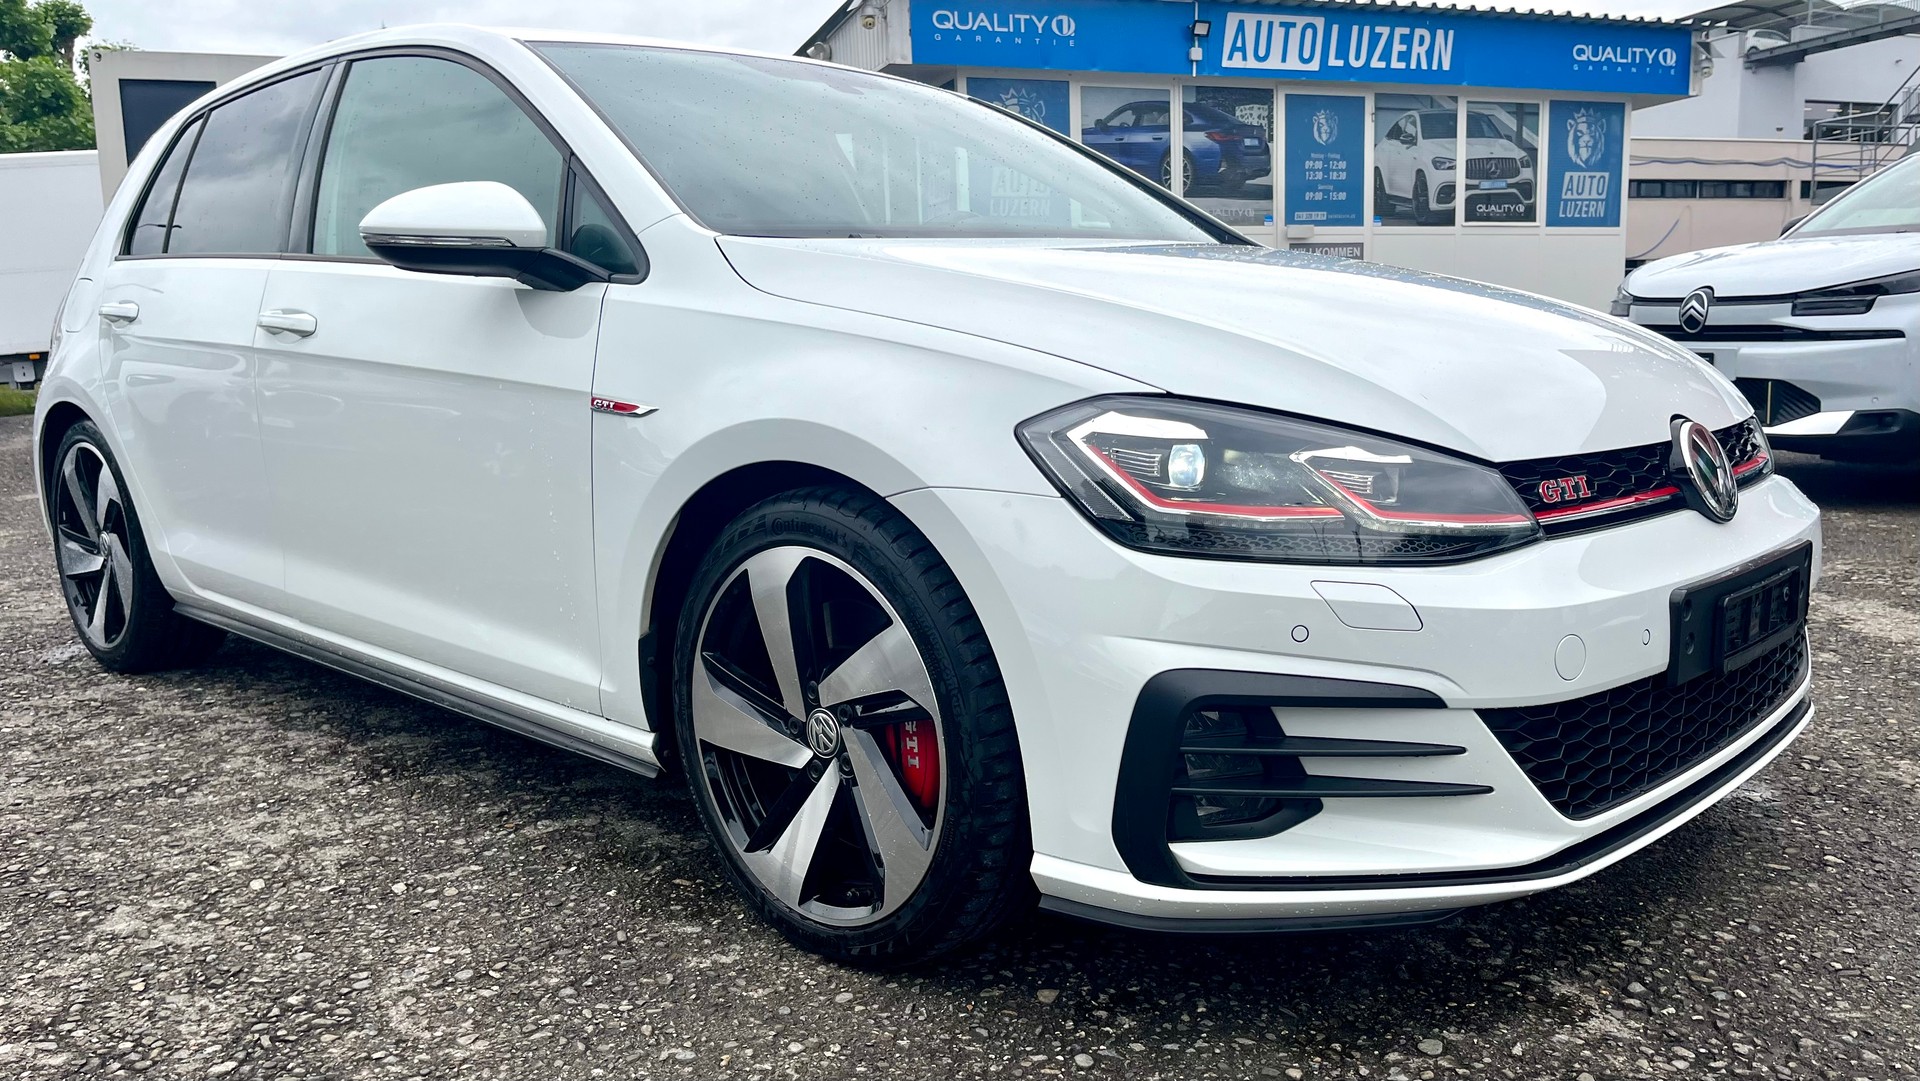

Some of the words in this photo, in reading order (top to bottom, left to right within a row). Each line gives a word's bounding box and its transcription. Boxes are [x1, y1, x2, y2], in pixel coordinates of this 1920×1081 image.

[932, 10, 1048, 34] QUALITY
[934, 33, 1075, 47] GARANTIE
[1226, 19, 1317, 65] AUTO
[1327, 24, 1454, 71] LUZERN
[1572, 44, 1657, 64] QUALITY
[1573, 64, 1675, 75] GARANTIE
[1304, 161, 1323, 170] 09:00
[1329, 161, 1347, 170] 12:00
[1564, 175, 1606, 196] AUTO
[1476, 204, 1515, 213] QUALITY
[1559, 201, 1605, 218] LUZERN
[593, 399, 615, 410] GTI
[1539, 475, 1591, 503] GTI
